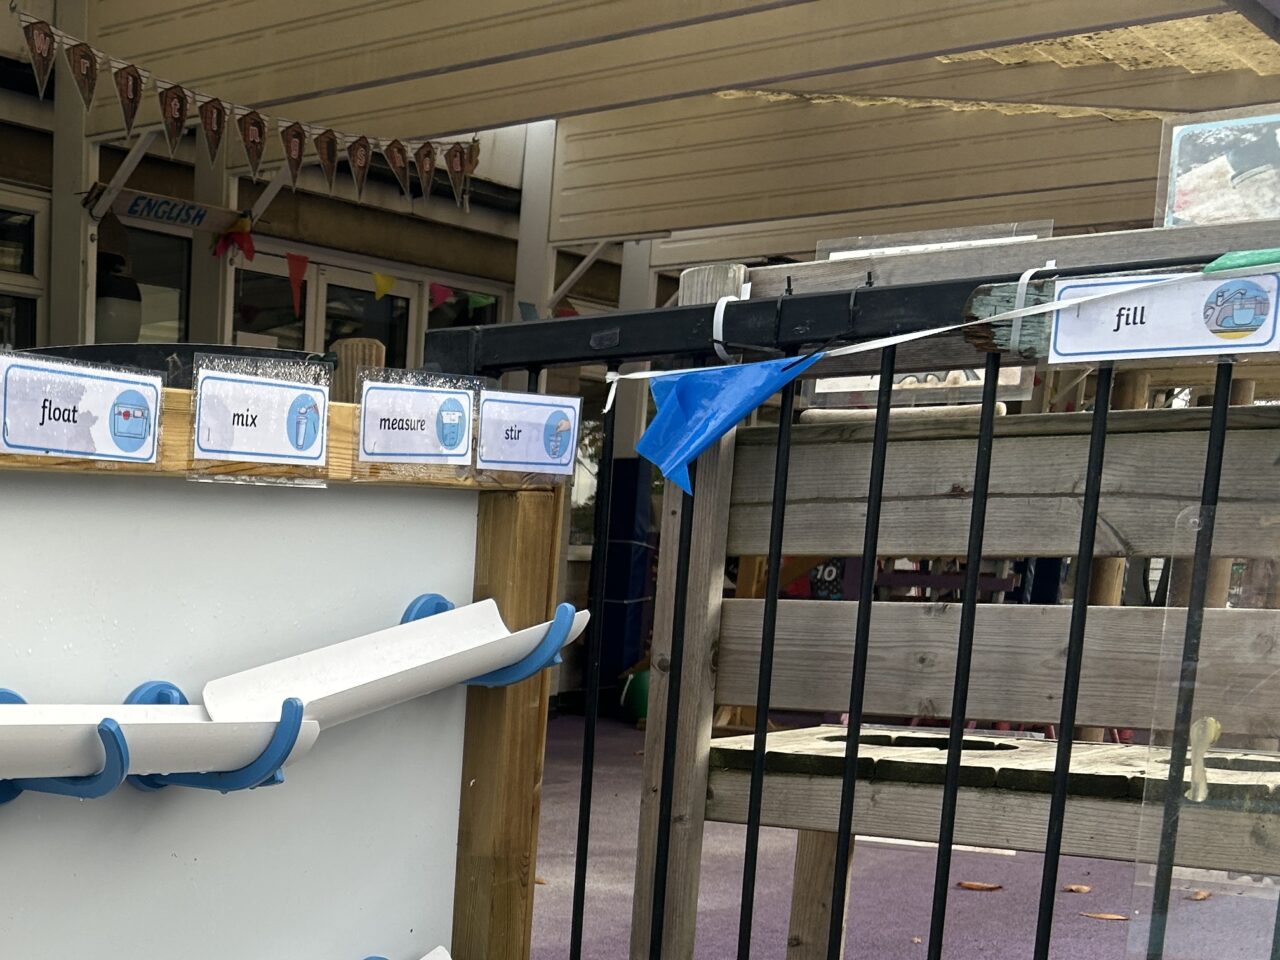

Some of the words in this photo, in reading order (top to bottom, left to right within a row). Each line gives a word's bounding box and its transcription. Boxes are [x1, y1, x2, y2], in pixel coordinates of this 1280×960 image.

[127, 195, 208, 227] ENGLISH
[1113, 306, 1146, 332] fill
[39, 398, 78, 426] float
[232, 408, 258, 427] mix
[379, 417, 426, 431] measure
[505, 424, 522, 440] stir
[816, 565, 837, 581] 10
